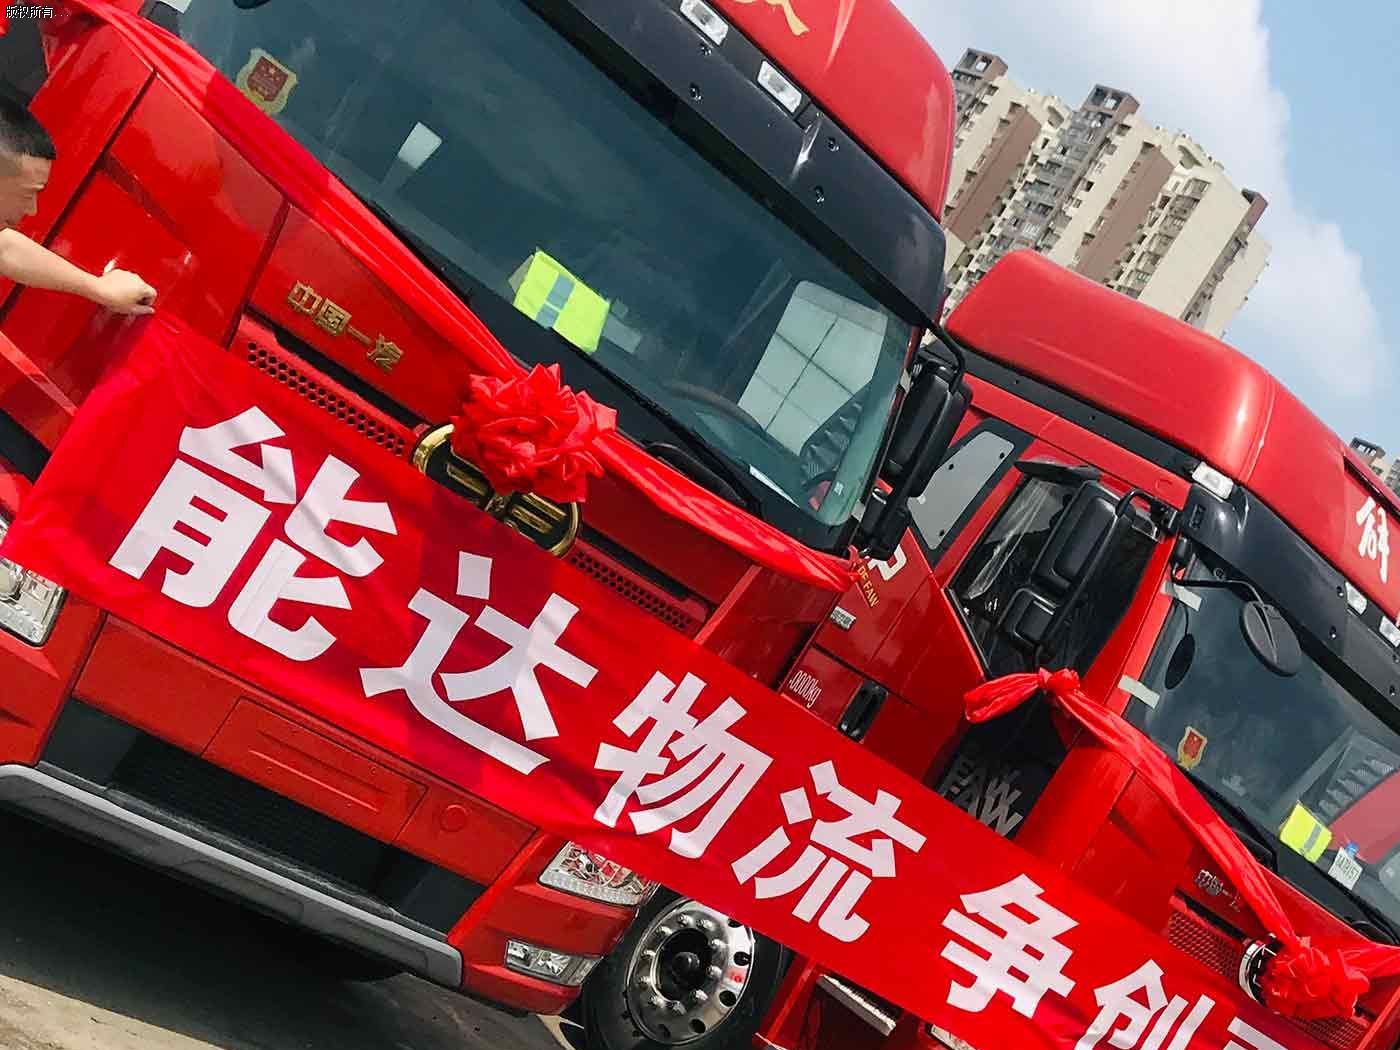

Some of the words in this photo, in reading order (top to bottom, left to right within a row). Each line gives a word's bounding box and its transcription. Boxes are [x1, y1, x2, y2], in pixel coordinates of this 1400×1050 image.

[287, 280, 405, 372] 中国一汽
[107, 406, 926, 944] 能达物流
[788, 669, 822, 708] 0000kg
